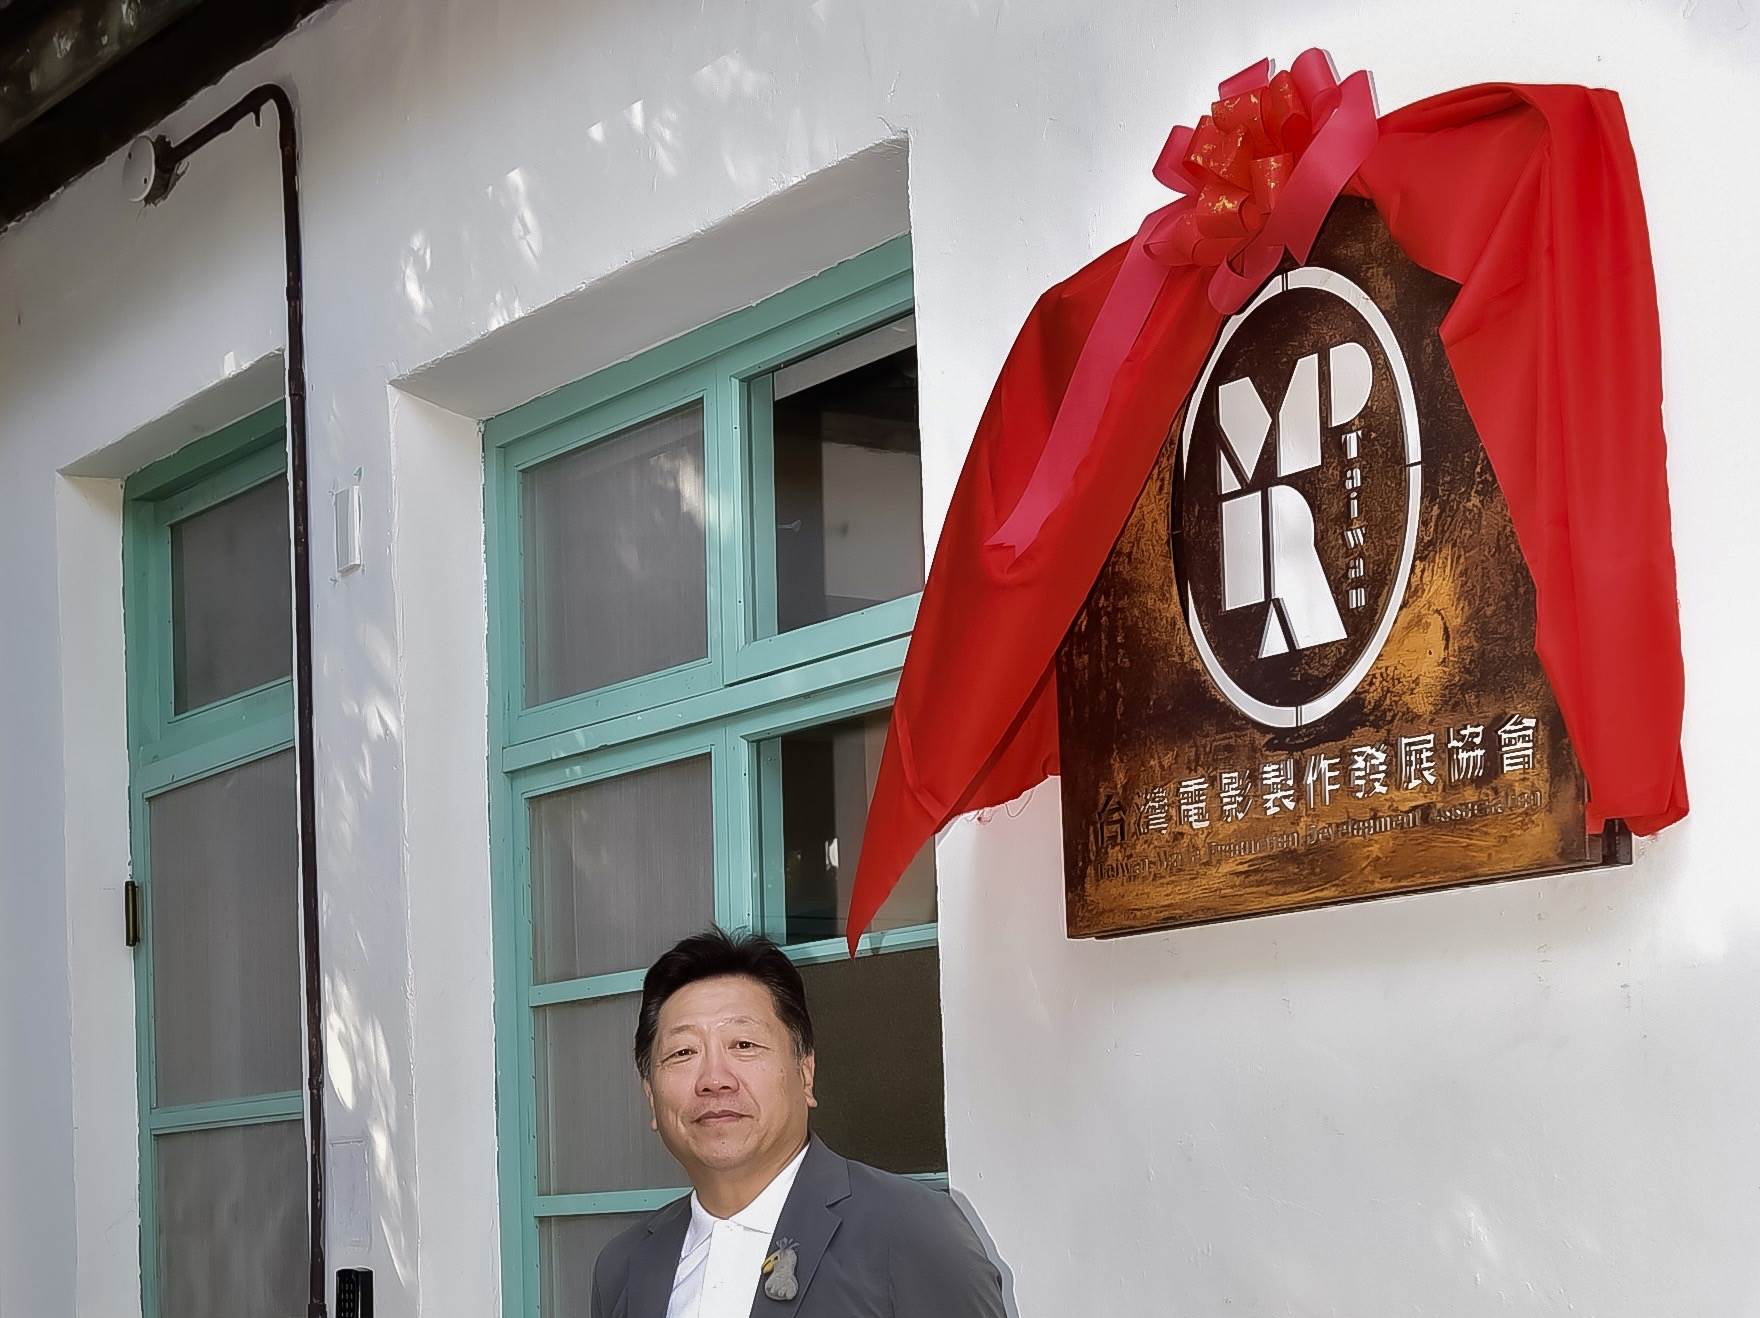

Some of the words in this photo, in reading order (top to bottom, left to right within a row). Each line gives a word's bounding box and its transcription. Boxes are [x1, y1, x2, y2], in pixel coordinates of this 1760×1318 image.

[1341, 430, 1367, 609] Taiwan
[1096, 713, 1537, 847] 台灣電影製作發展協會
